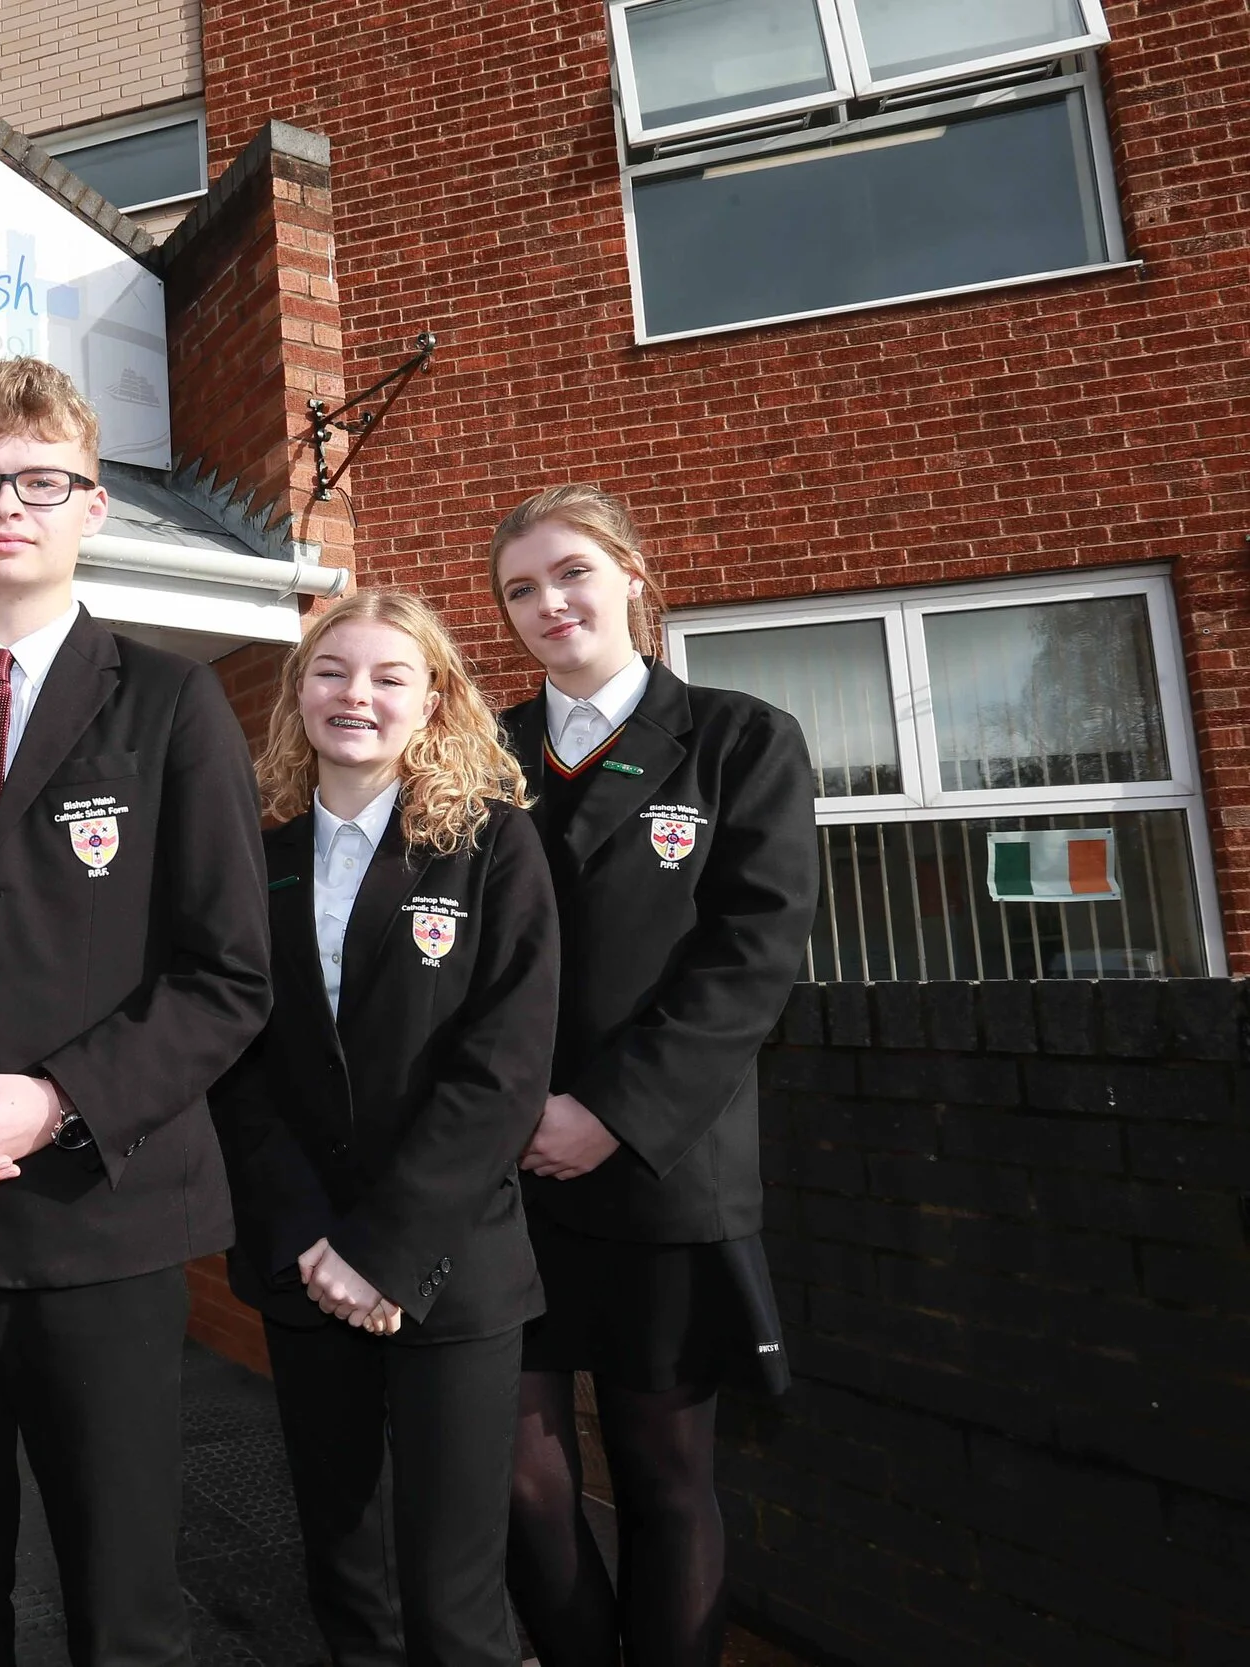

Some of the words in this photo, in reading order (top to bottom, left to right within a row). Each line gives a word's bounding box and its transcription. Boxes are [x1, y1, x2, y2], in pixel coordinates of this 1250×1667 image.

[63, 800, 91, 810] Bishop
[92, 796, 116, 806] Walsh
[649, 804, 677, 812] Bishop
[676, 804, 699, 815] Walsh
[54, 810, 85, 822] Catholic
[85, 808, 106, 818] Sixth
[108, 806, 129, 815] Form
[670, 813, 689, 822] Sixth
[689, 815, 708, 825] Form
[412, 896, 438, 905] Bishop
[438, 896, 459, 907] Walsh
[401, 904, 430, 912] Catholic
[430, 905, 449, 915] Sixth
[450, 908, 468, 918] Form
